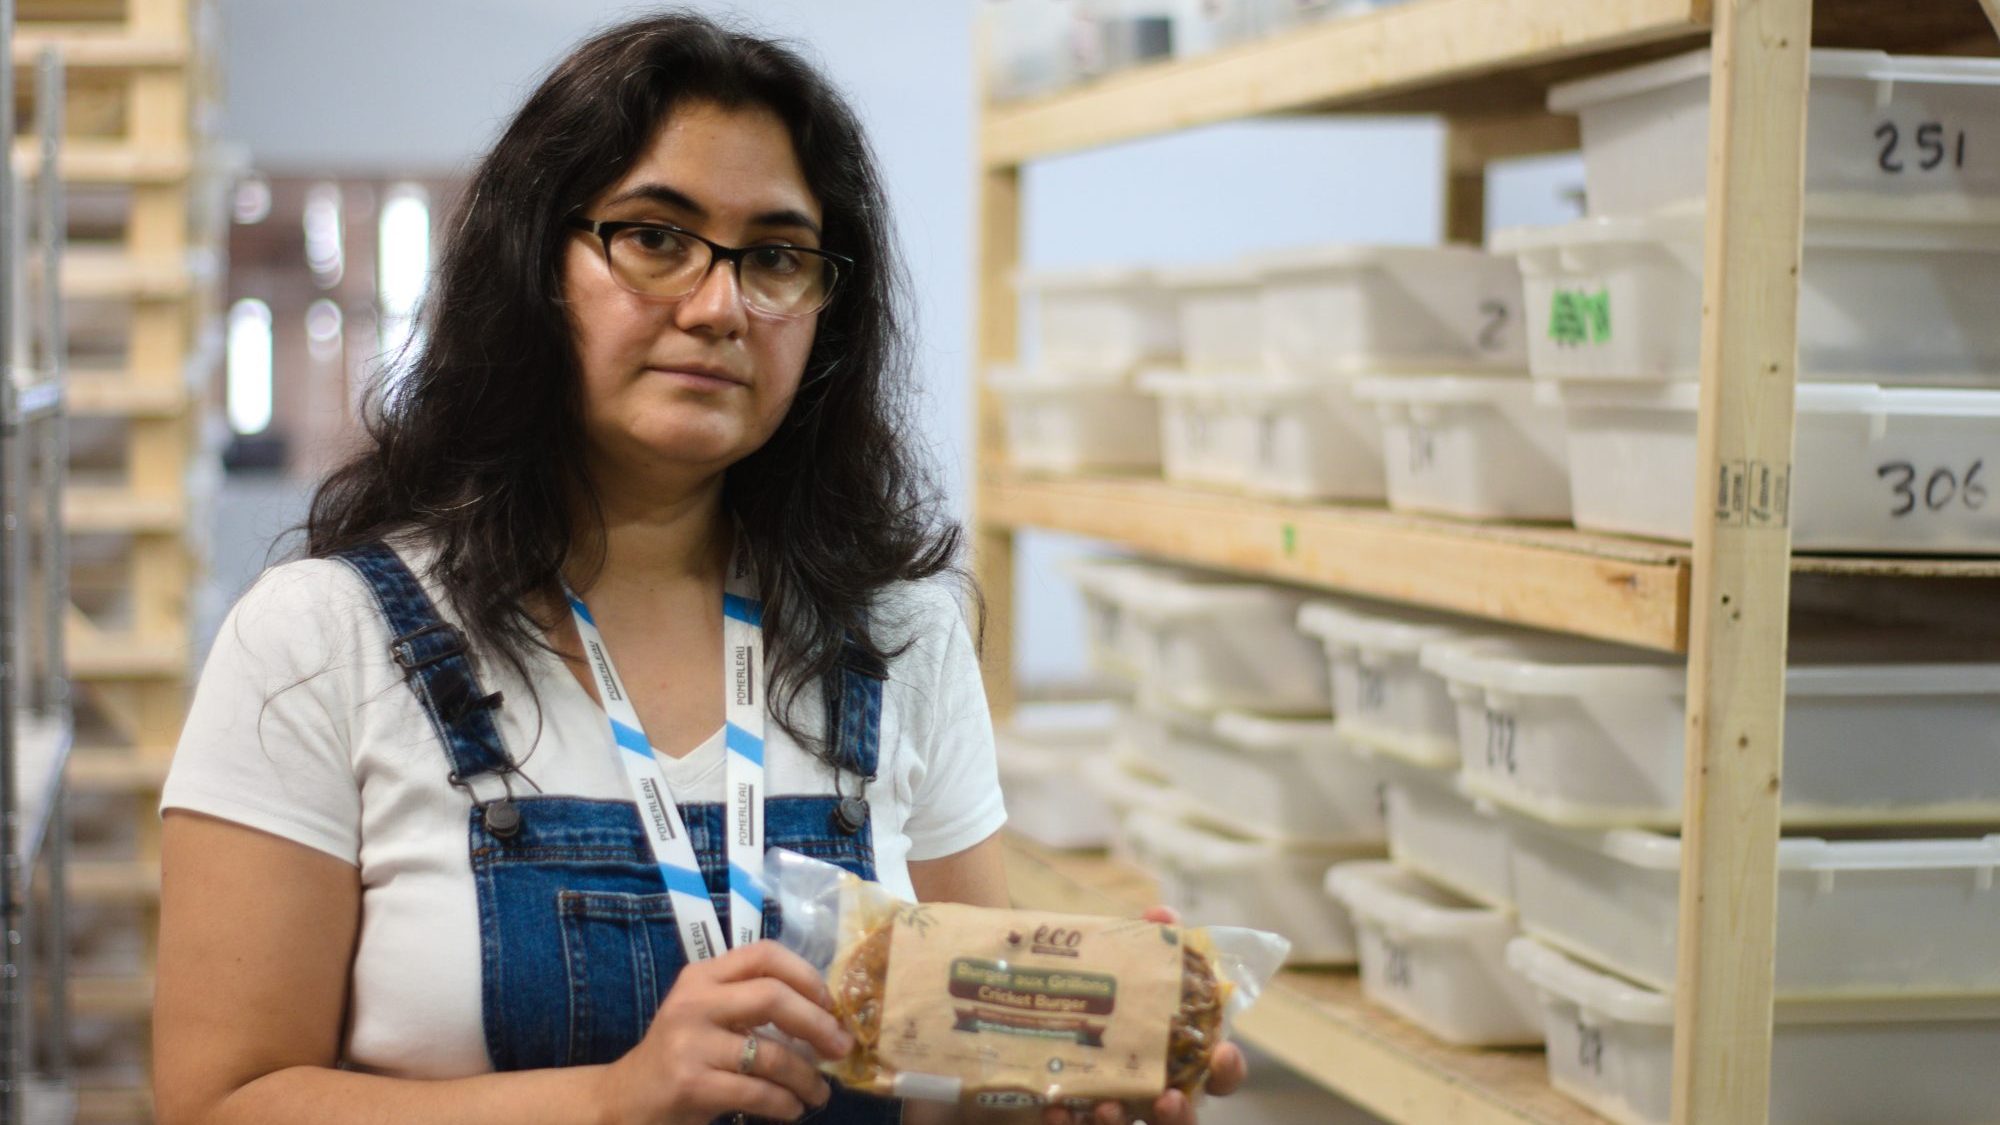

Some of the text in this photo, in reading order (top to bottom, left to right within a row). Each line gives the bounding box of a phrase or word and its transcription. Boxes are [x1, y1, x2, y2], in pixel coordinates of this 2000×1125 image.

[1874, 122, 1965, 173] 251
[1877, 459, 1989, 518] 306
[588, 639, 617, 701] POMERLEAU
[736, 645, 746, 706] POMERLEAU
[640, 777, 669, 842] POMERLEAU
[738, 782, 748, 846] POMERLEAU
[1033, 925, 1083, 948] eco
[977, 984, 1088, 1013] Cricket Burger
